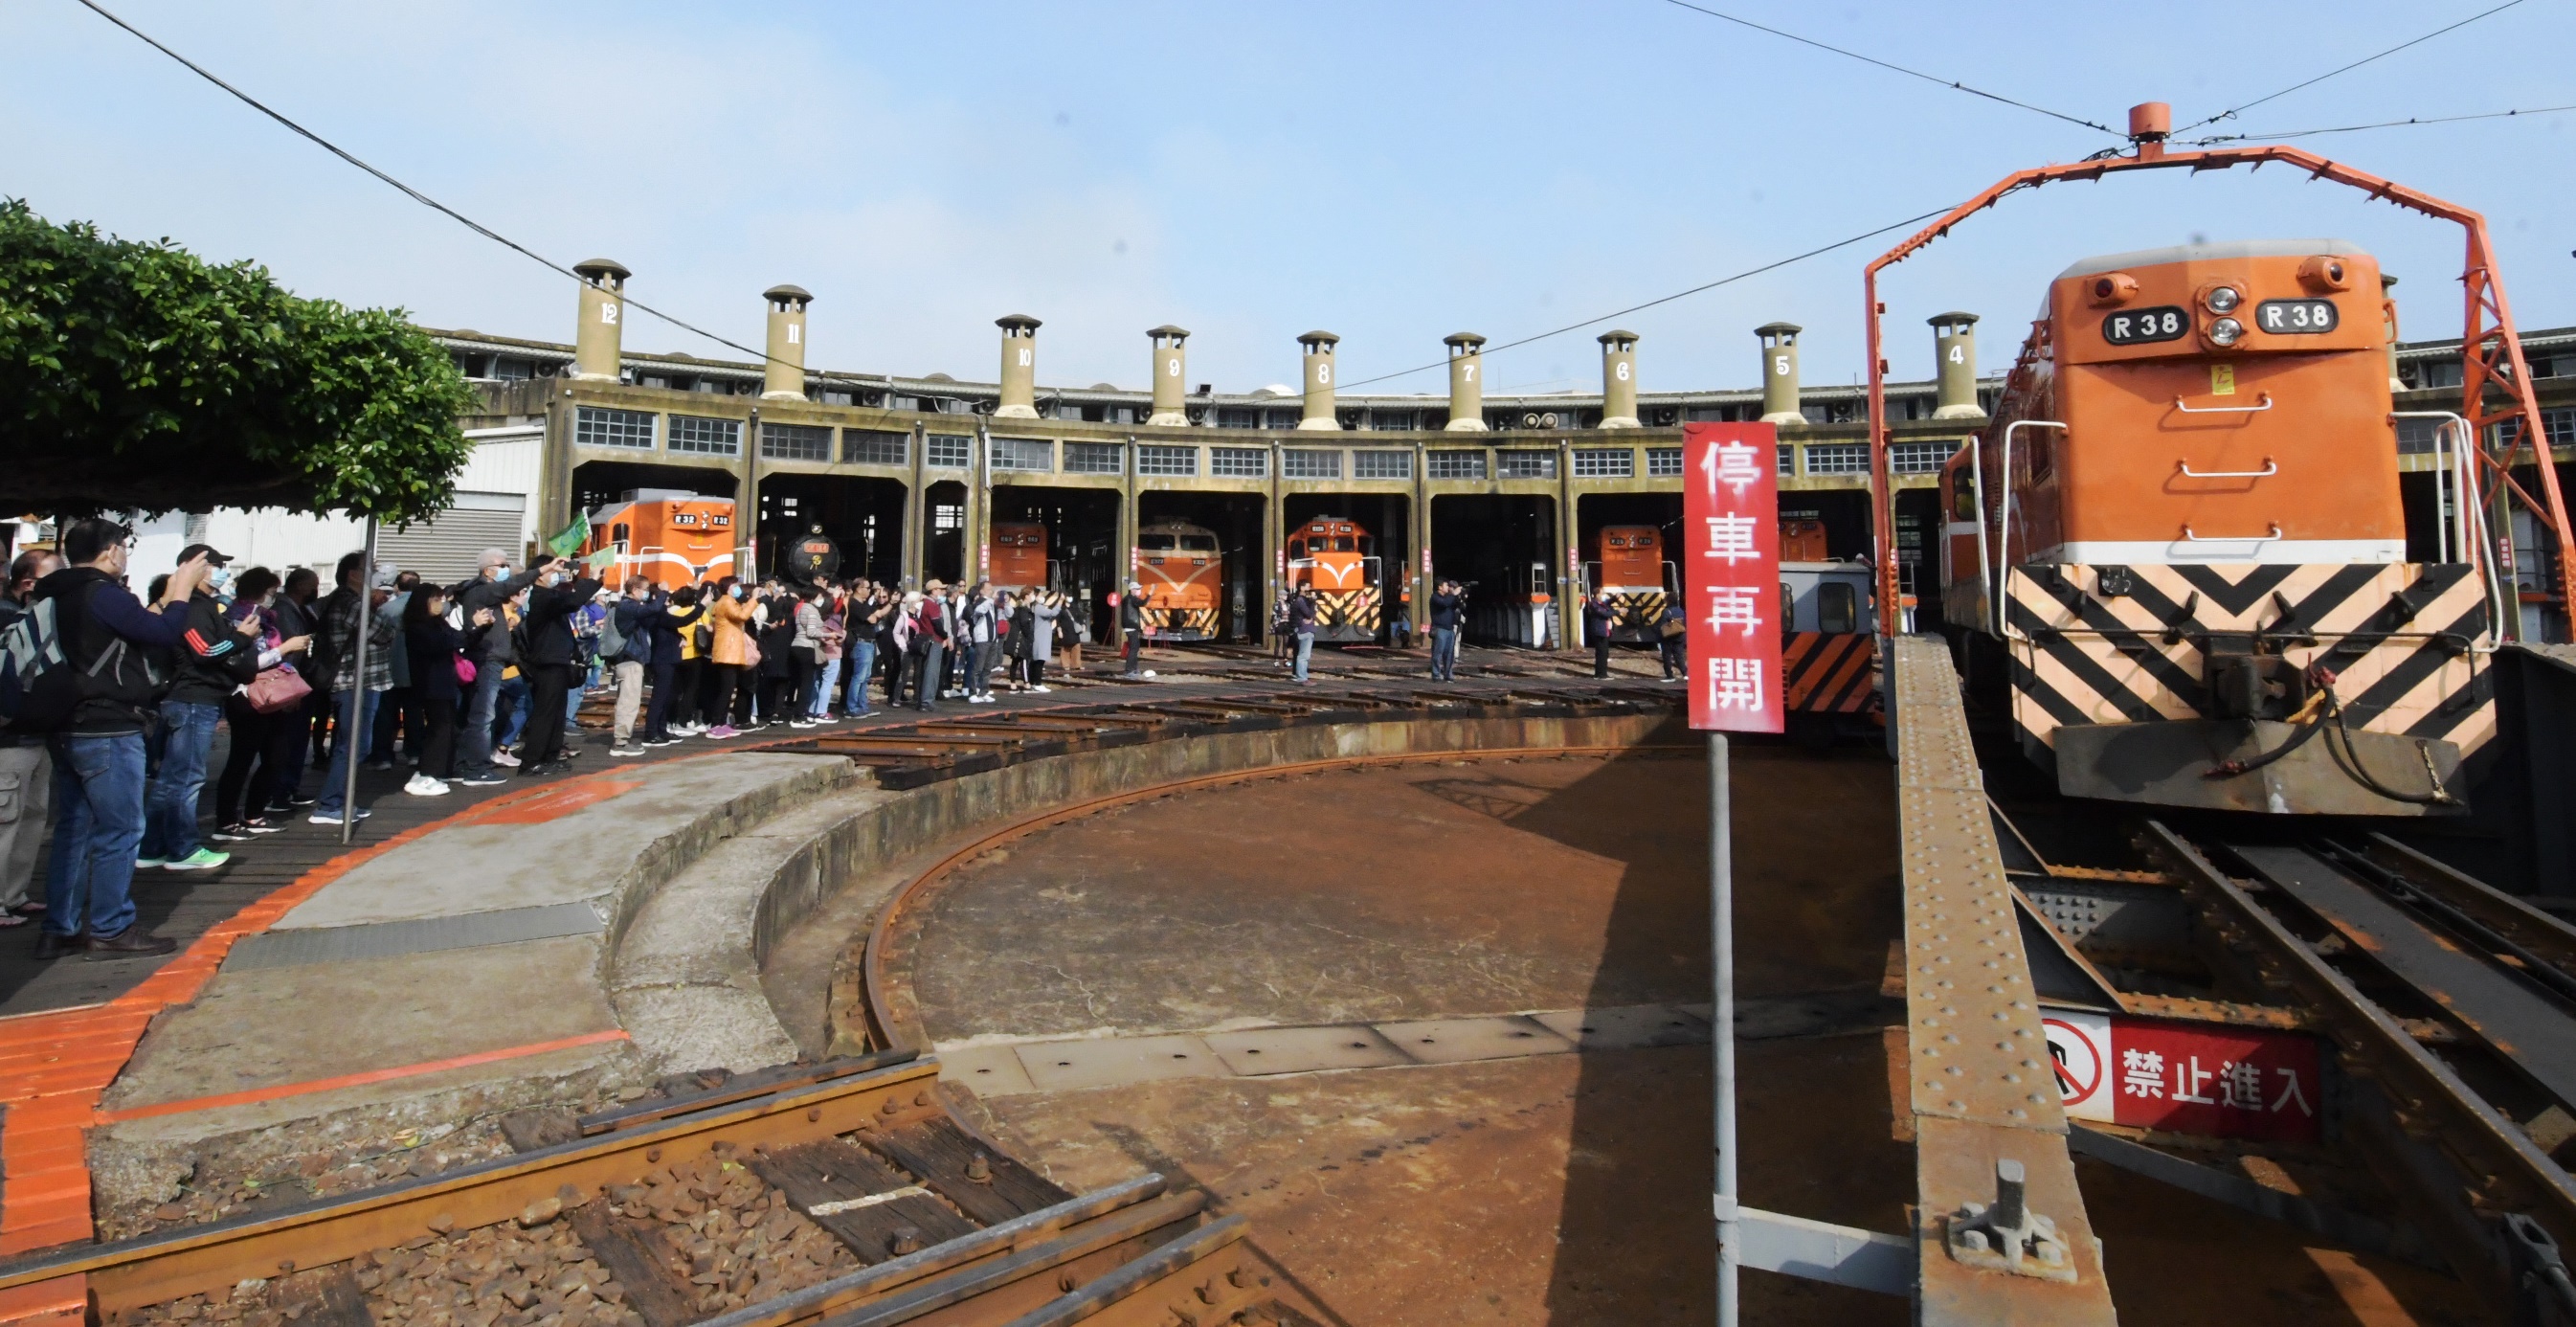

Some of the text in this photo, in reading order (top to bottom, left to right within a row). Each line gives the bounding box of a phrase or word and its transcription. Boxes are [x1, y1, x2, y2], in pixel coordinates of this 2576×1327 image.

[601, 303, 617, 325] 12
[2266, 304, 2329, 327] R 38
[788, 324, 799, 344] 11
[2114, 312, 2179, 339] R 38
[1019, 348, 1031, 367] 10
[1776, 355, 1790, 375] 5
[1949, 345, 1964, 365] 4
[1169, 358, 1180, 377] 9
[1318, 363, 1330, 384] 8
[1463, 365, 1475, 382] 7
[1616, 362, 1629, 381] 6
[675, 515, 695, 524] R 32
[713, 516, 728, 526] R 32
[1699, 440, 1764, 711] 停車再開
[2122, 1047, 2313, 1118] 禁止進入
